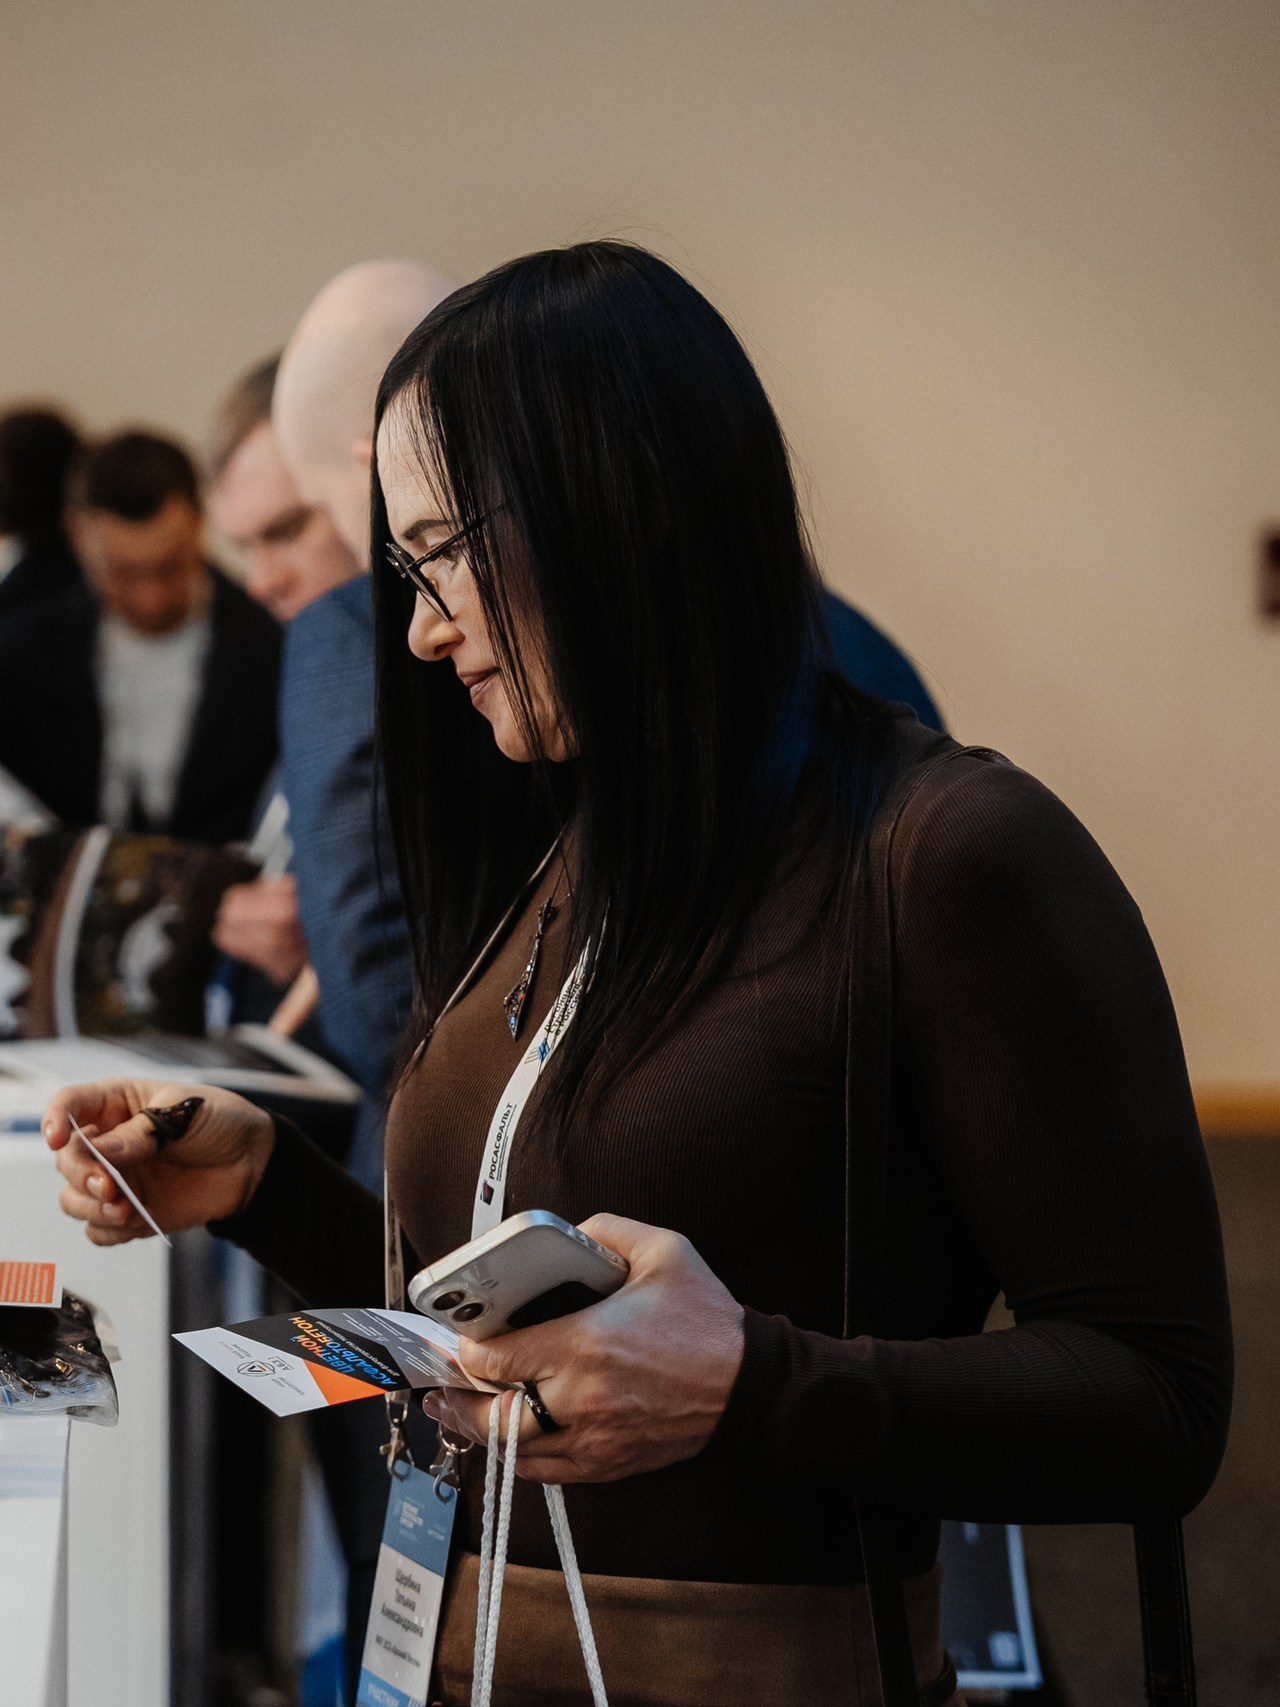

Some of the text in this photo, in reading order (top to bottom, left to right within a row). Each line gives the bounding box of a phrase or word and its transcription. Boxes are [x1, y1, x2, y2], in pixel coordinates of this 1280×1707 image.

[488, 1102, 513, 1180] РОСАСФАЛЬТ
[288, 1316, 398, 1385] АСФАЛЬТОБЕТОН
[289, 1334, 356, 1374] ЦВЕТНОЙ
